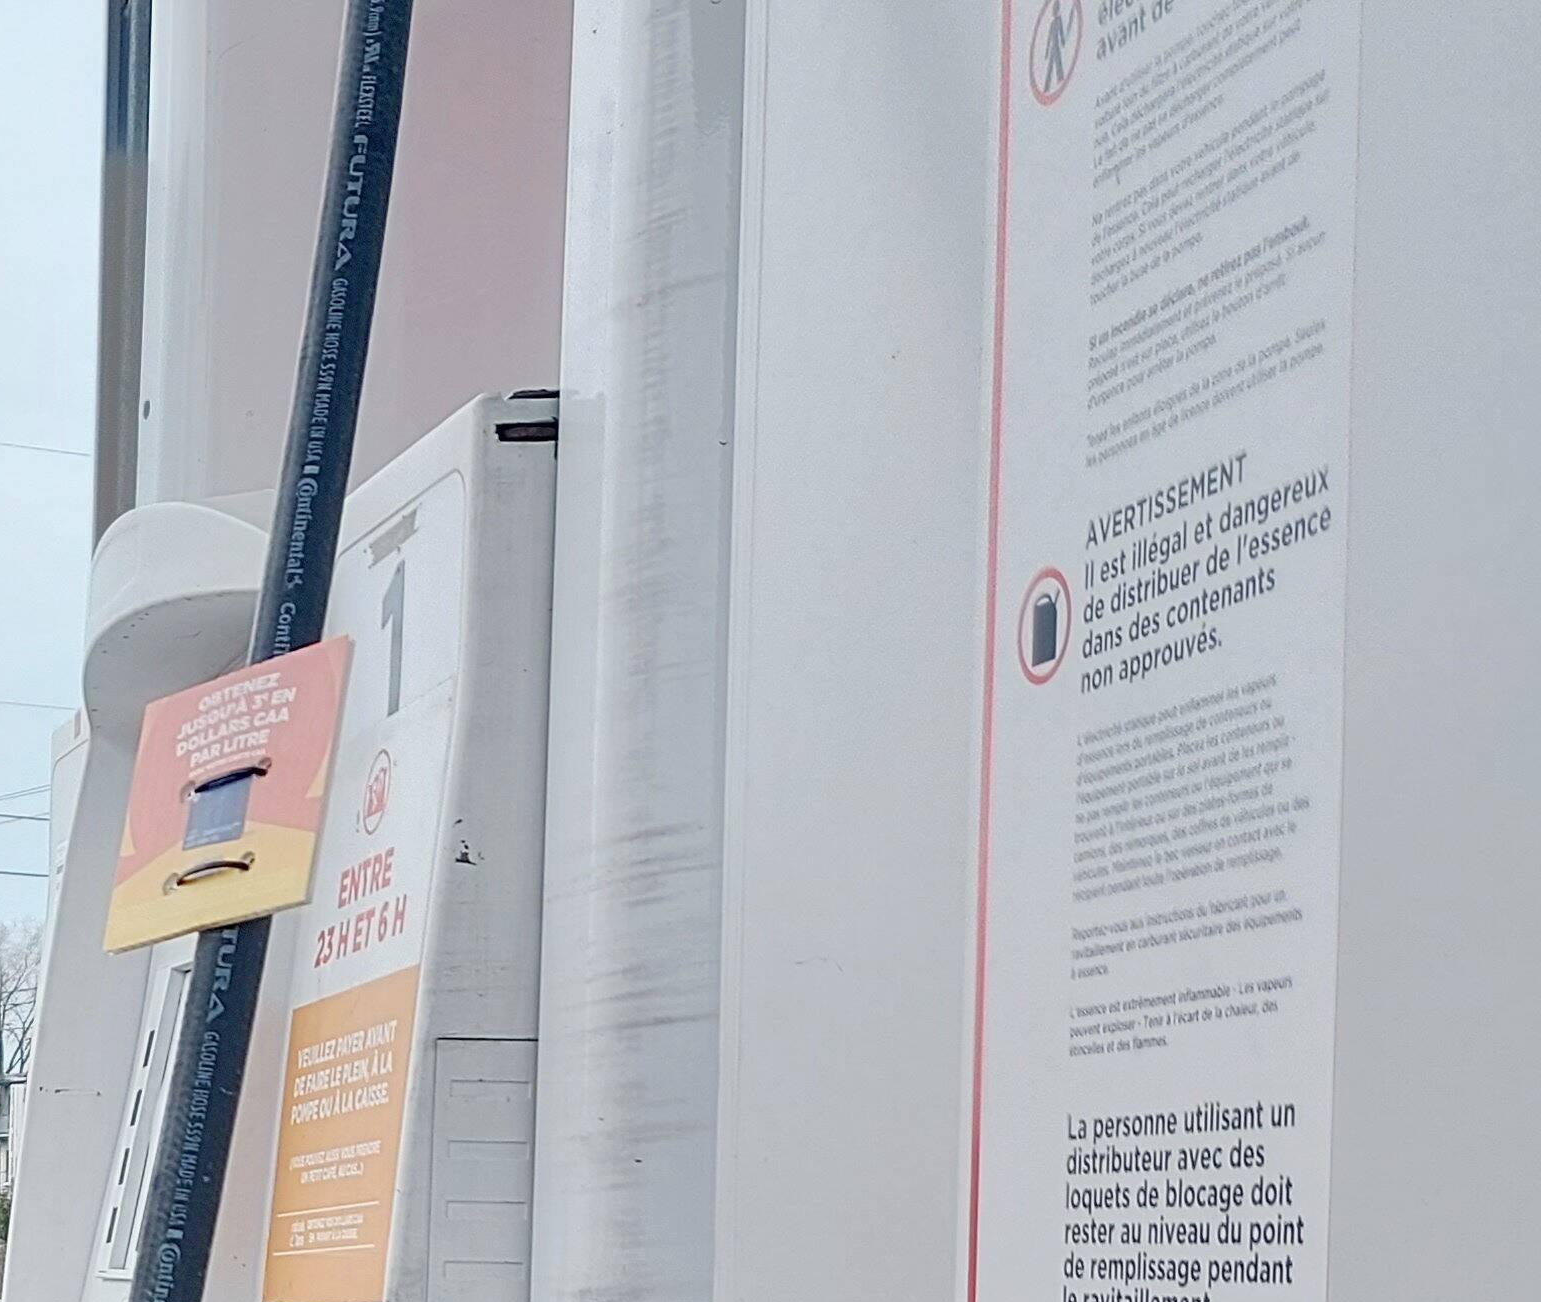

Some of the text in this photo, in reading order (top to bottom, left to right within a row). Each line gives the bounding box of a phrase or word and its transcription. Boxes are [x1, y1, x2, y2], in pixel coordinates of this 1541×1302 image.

[334, 134, 369, 272] FUTURA
[325, 277, 349, 330] GASOLINE
[320, 330, 340, 361] HOSE
[311, 392, 331, 424] MADE
[305, 440, 323, 464] USA
[1085, 452, 1247, 550] AVERTISSEMENT
[1085, 469, 1329, 591] Il est illégal et dangereux
[1083, 507, 1332, 624] de distribuer de l'essence
[1082, 567, 1276, 659] dans des contenants
[381, 558, 406, 718] 1
[1081, 622, 1222, 694] non approuvés.
[198, 672, 281, 712] OBTENEZ
[270, 686, 297, 705] EN
[175, 706, 290, 757] DOLLARS CAA
[190, 744, 221, 768] PAR
[222, 729, 271, 755] LITRE
[337, 846, 395, 910] ENTRE
[313, 893, 407, 969] 23 H ET 6 H
[193, 1031, 220, 1087] GASOLINE
[379, 1050, 393, 1076] LA
[188, 1087, 211, 1120] HOSE
[1068, 1100, 1296, 1145] La personne utilisant un
[176, 1152, 198, 1186] MADE
[1066, 1138, 1265, 1175] distributeur avec des
[168, 1204, 188, 1226] USA
[1065, 1174, 1293, 1215] loquets de blocage doit
[1064, 1213, 1305, 1252] rester au niveau du point
[1063, 1251, 1293, 1289] de remplissage pendant
